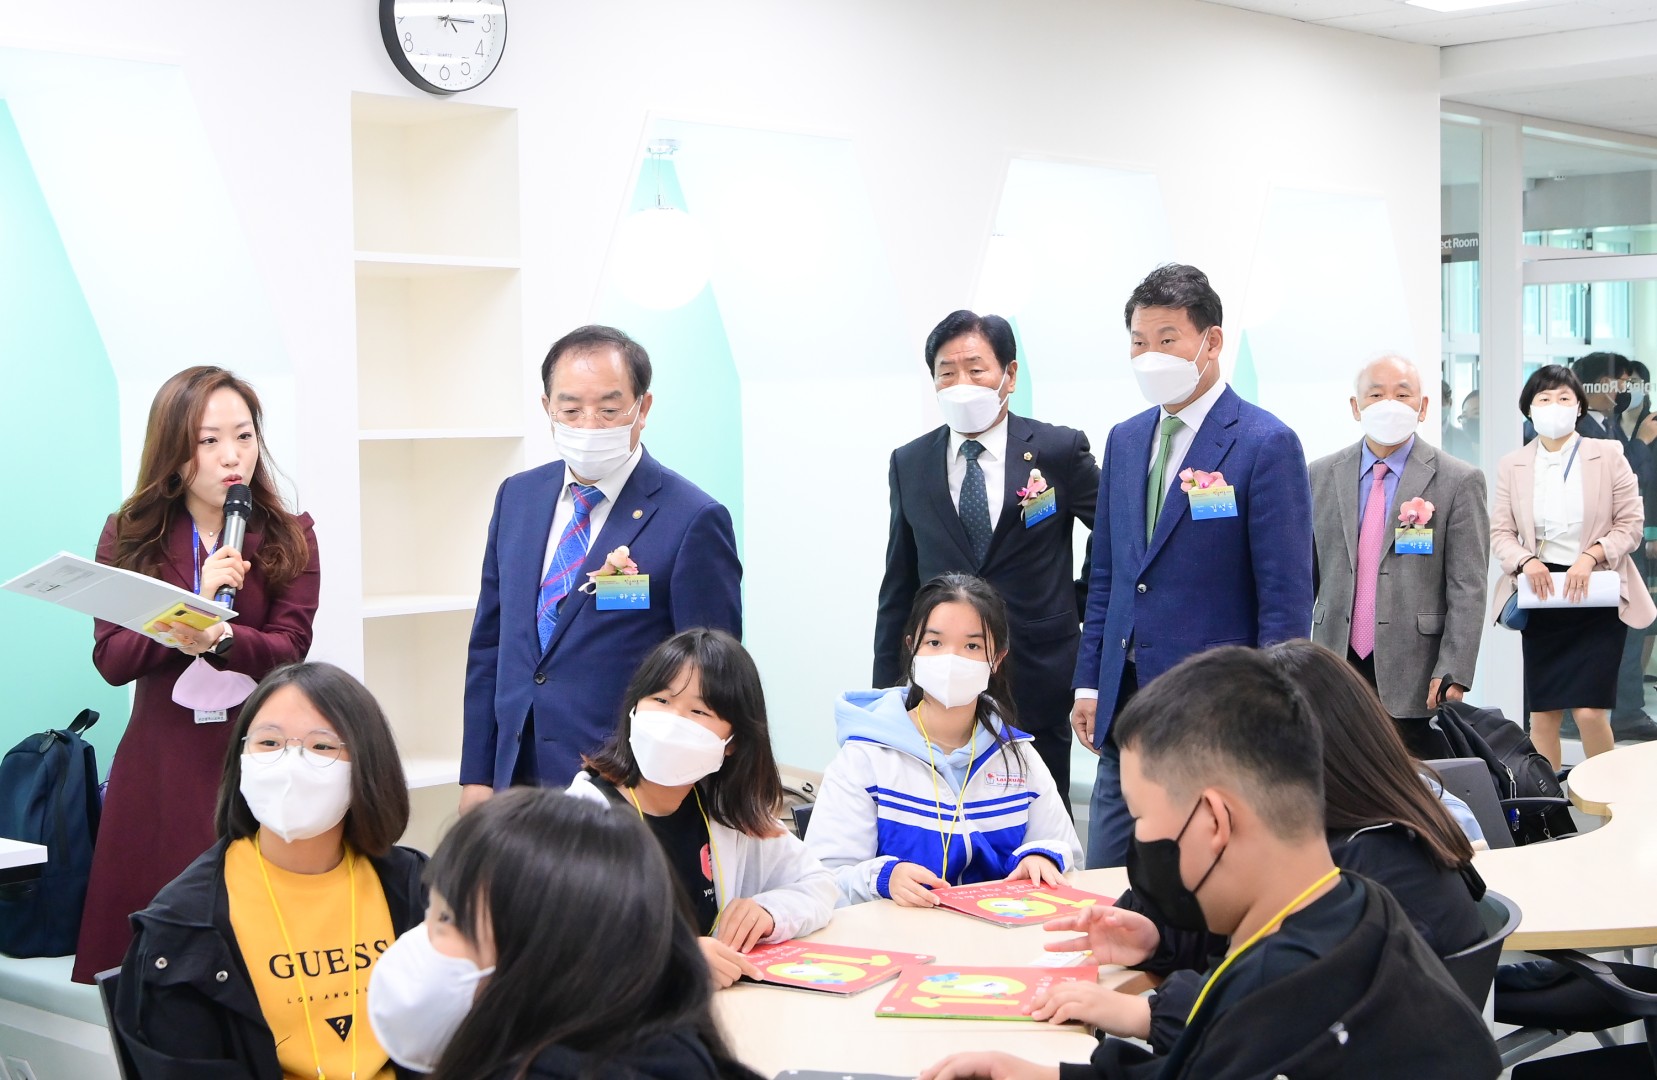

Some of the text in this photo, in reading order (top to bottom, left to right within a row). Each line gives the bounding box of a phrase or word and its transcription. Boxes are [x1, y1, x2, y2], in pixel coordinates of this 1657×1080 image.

[403, 32, 414, 52] 8
[474, 39, 485, 57] 4
[439, 64, 451, 80] 6
[1453, 237, 1479, 248] Room
[287, 995, 314, 1004] LOS
